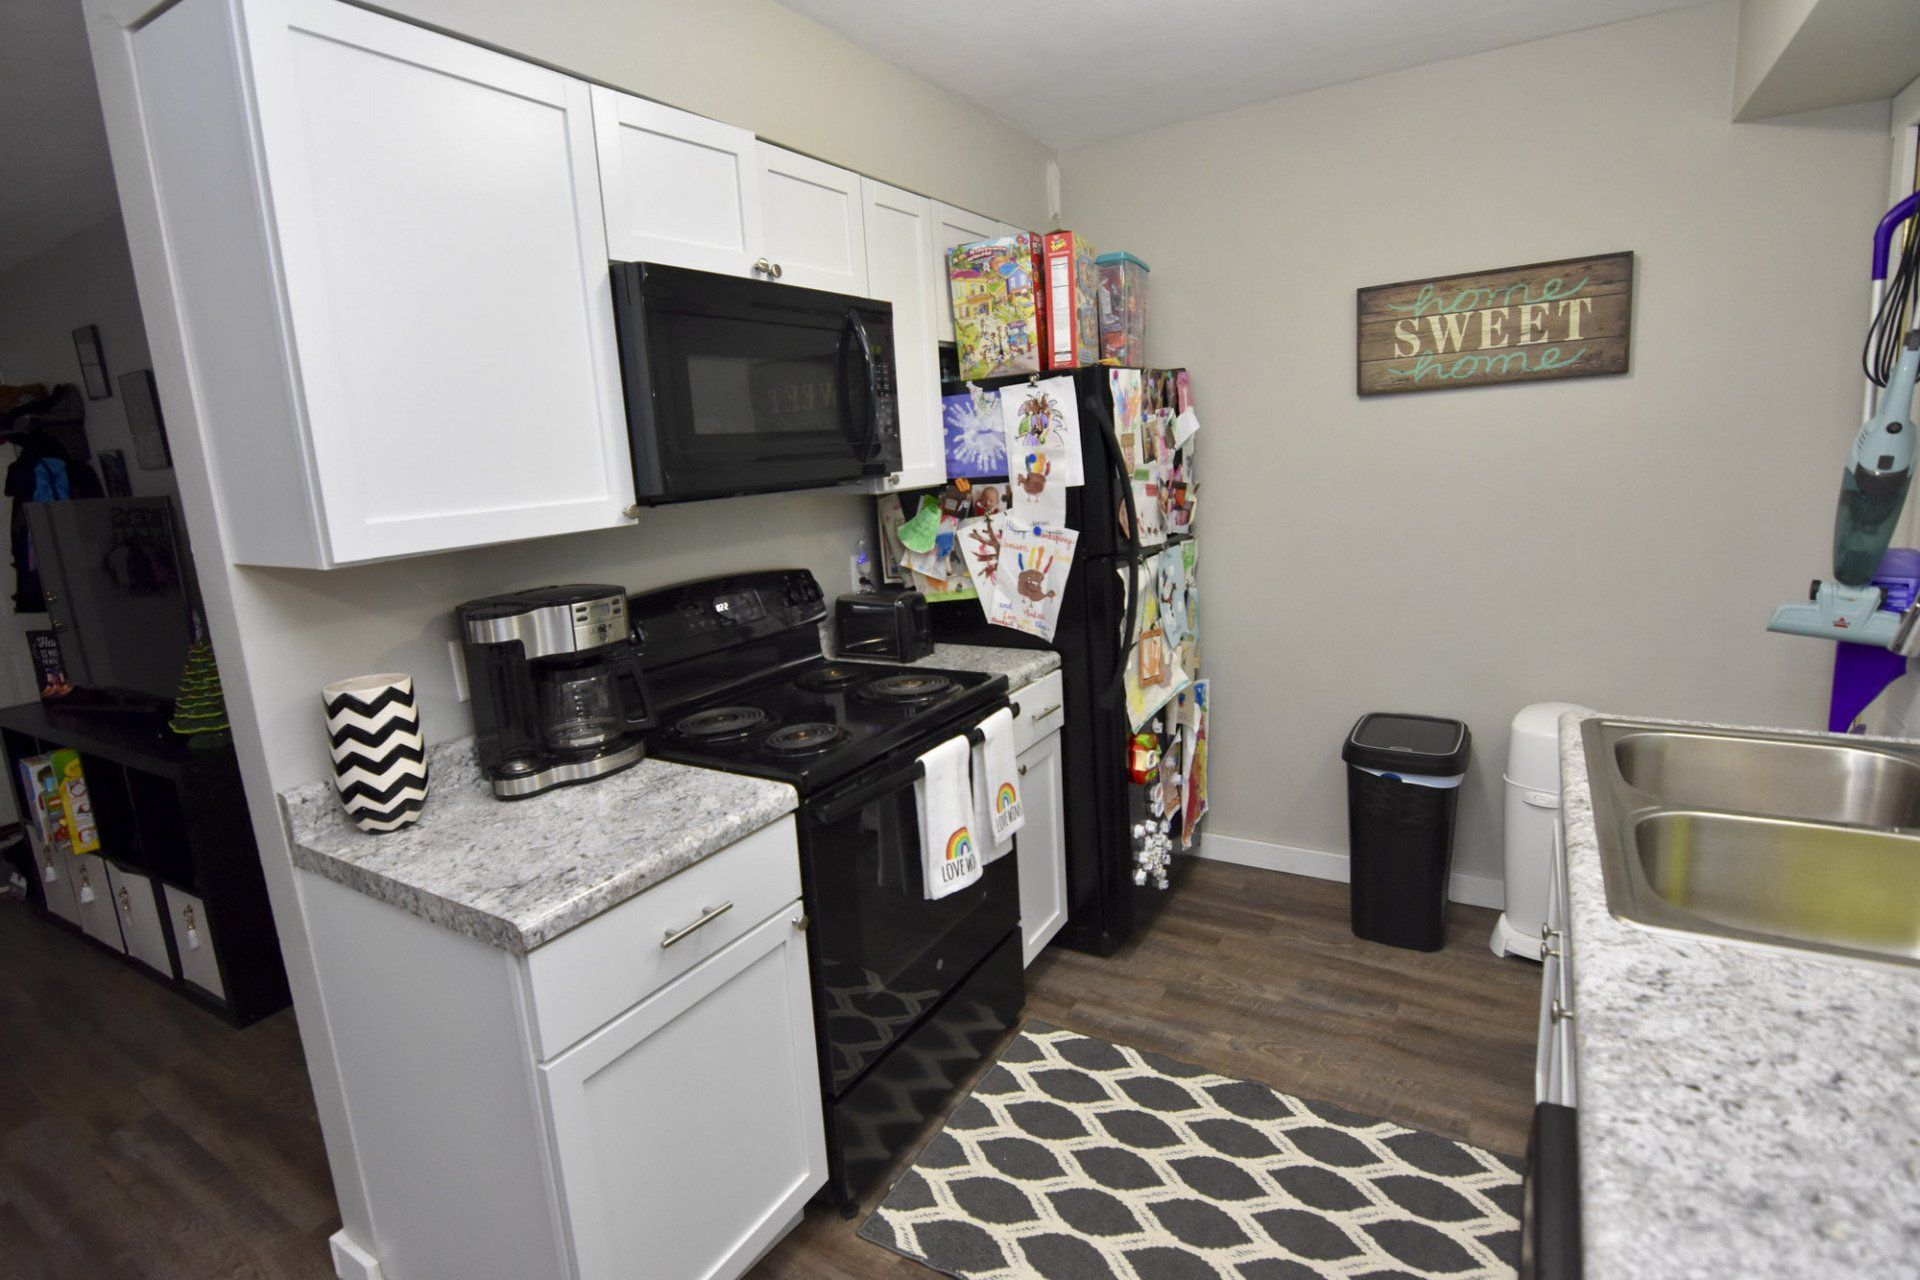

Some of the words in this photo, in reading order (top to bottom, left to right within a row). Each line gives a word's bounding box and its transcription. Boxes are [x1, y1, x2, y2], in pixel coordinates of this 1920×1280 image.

[1387, 276, 1589, 317] home
[1394, 297, 1592, 359] SWEET
[1387, 346, 1586, 383] home
[941, 857, 966, 883] LOVE
